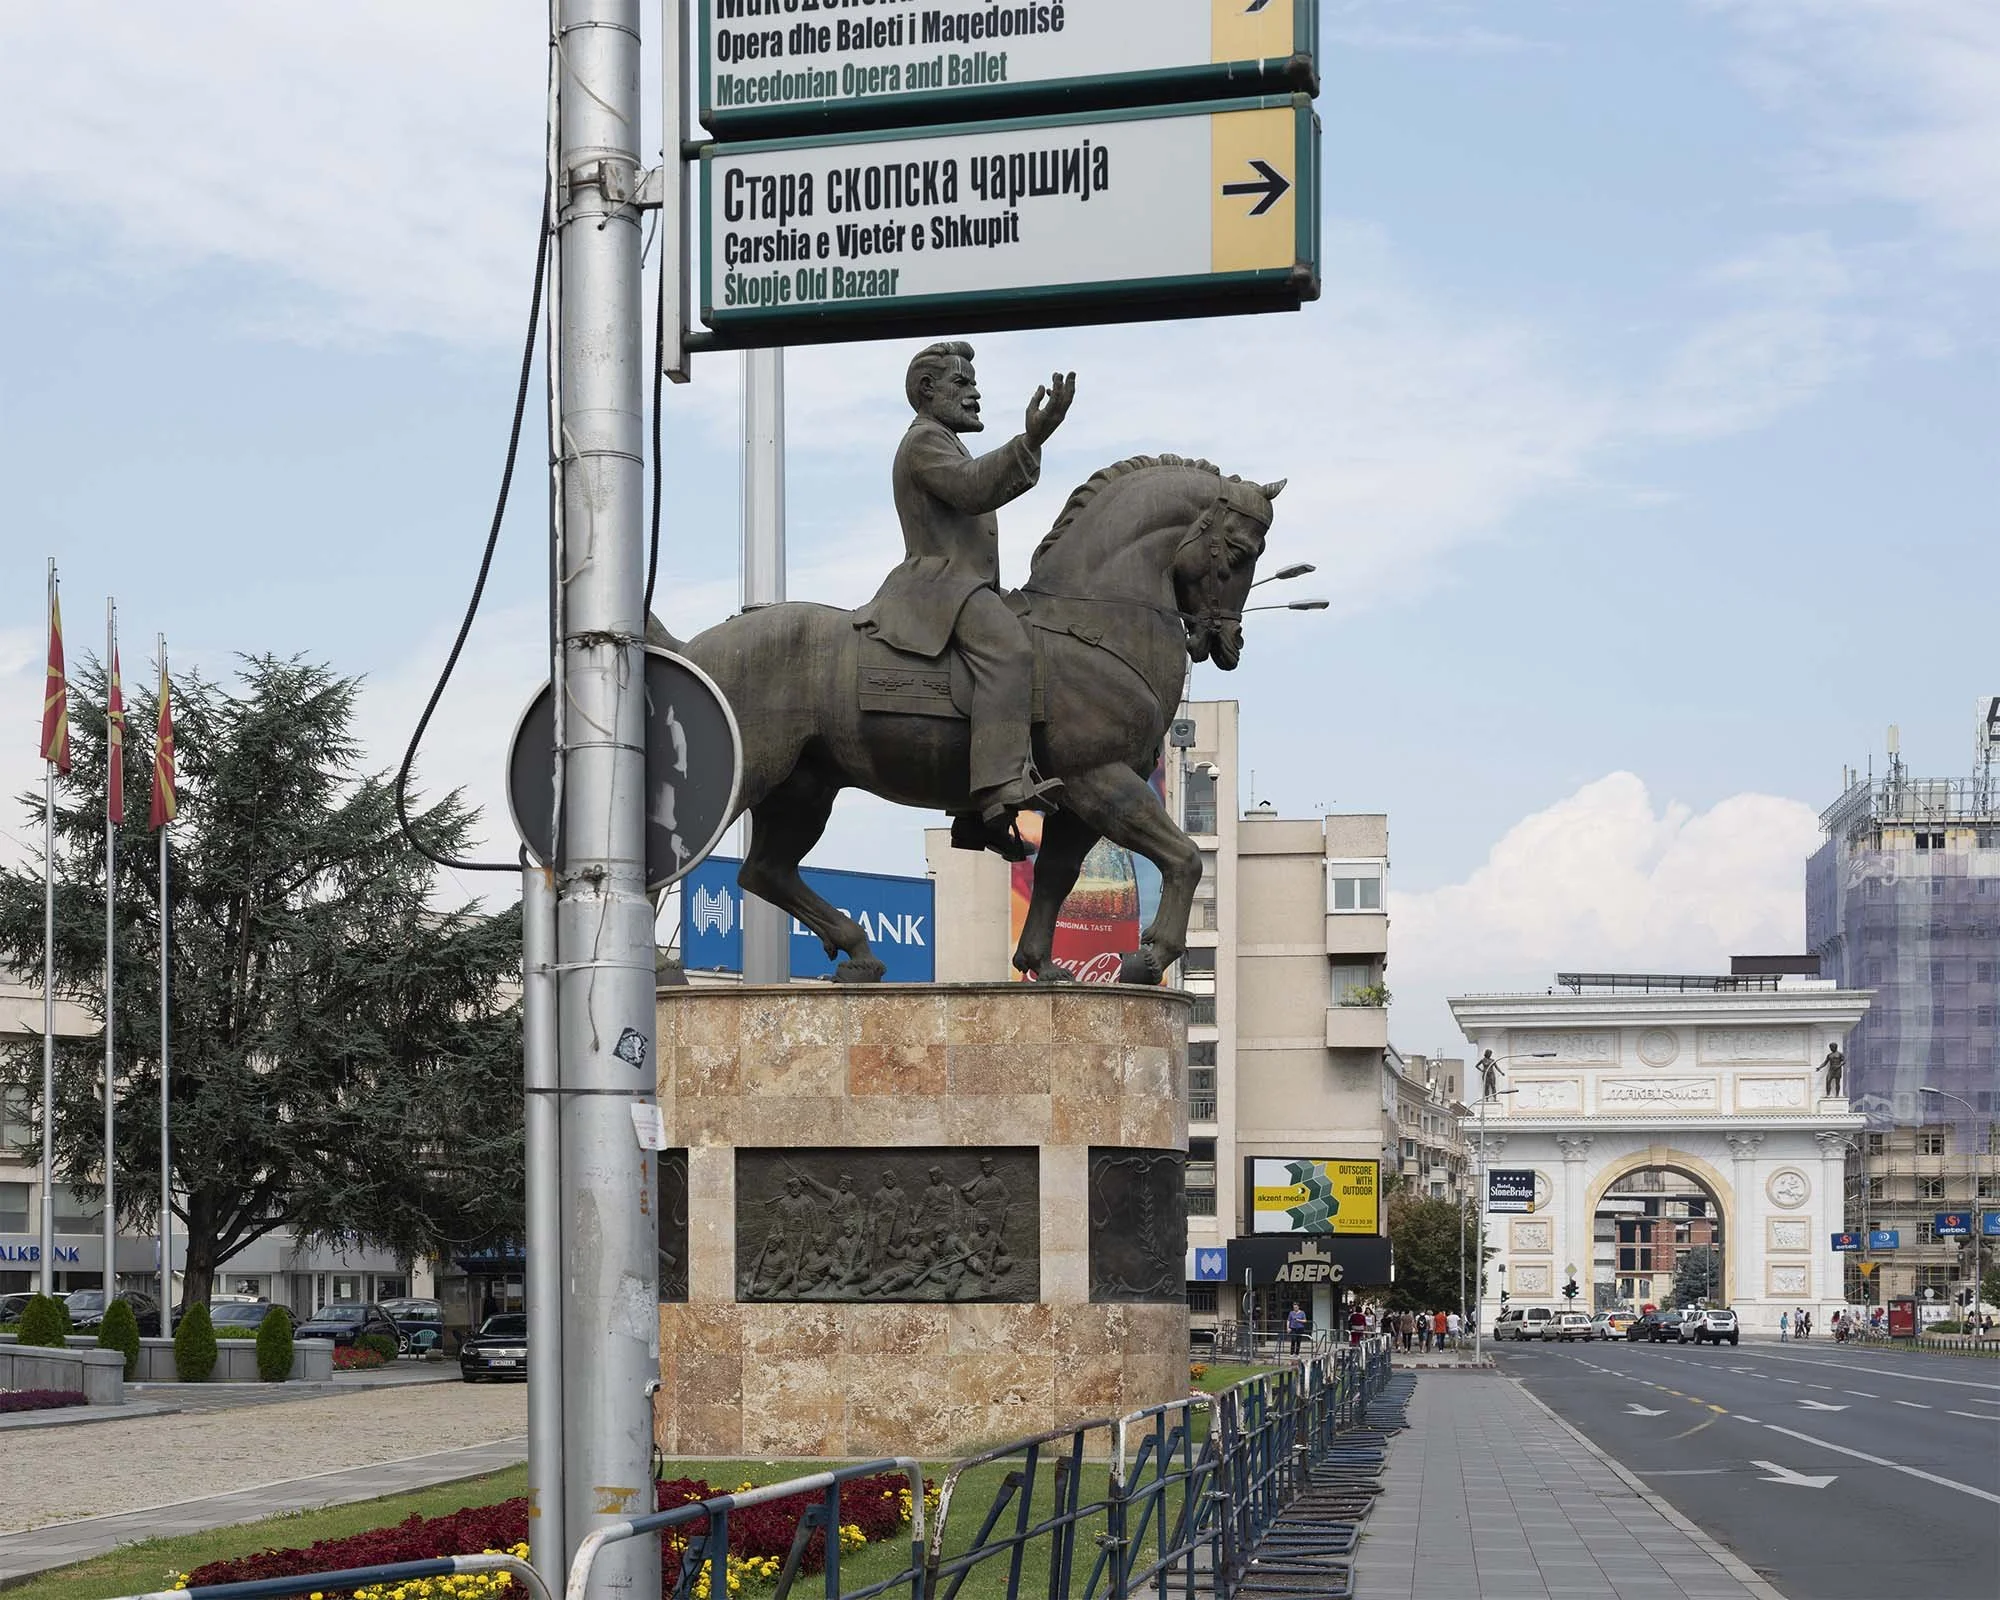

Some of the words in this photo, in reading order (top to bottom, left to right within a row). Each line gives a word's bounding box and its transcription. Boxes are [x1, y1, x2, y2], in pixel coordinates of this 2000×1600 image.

[717, 29, 783, 64] Opera
[788, 22, 830, 56] dhe
[836, 13, 903, 51] Baleti
[908, 12, 916, 45] i
[921, 0, 1065, 44] Maqedonisë
[717, 66, 837, 107] Macedonian
[843, 62, 900, 97] Opera
[905, 55, 943, 90] and
[948, 51, 1008, 87] Ballet
[723, 167, 814, 227] Стара
[827, 158, 958, 215] скопска
[970, 139, 1109, 207] чаршија
[724, 227, 811, 272] Çarshia
[817, 232, 830, 260] e
[911, 224, 925, 252] e
[931, 210, 1020, 250] Shkupit
[724, 270, 791, 307] Skopje
[795, 266, 828, 303] Old
[832, 265, 900, 300] Bazaar
[740, 899, 926, 946] LANK
[1091, 924, 1113, 932] TASTE
[1339, 1165, 1373, 1175] OUTSCORE
[1355, 1176, 1373, 1186] WITH
[1257, 1194, 1282, 1202] akzent
[1284, 1194, 1306, 1202] media
[1342, 1186, 1373, 1196] OUTDOOR
[1490, 1185, 1533, 1198] StoneBridge
[0, 1246, 79, 1262] ALKBNK
